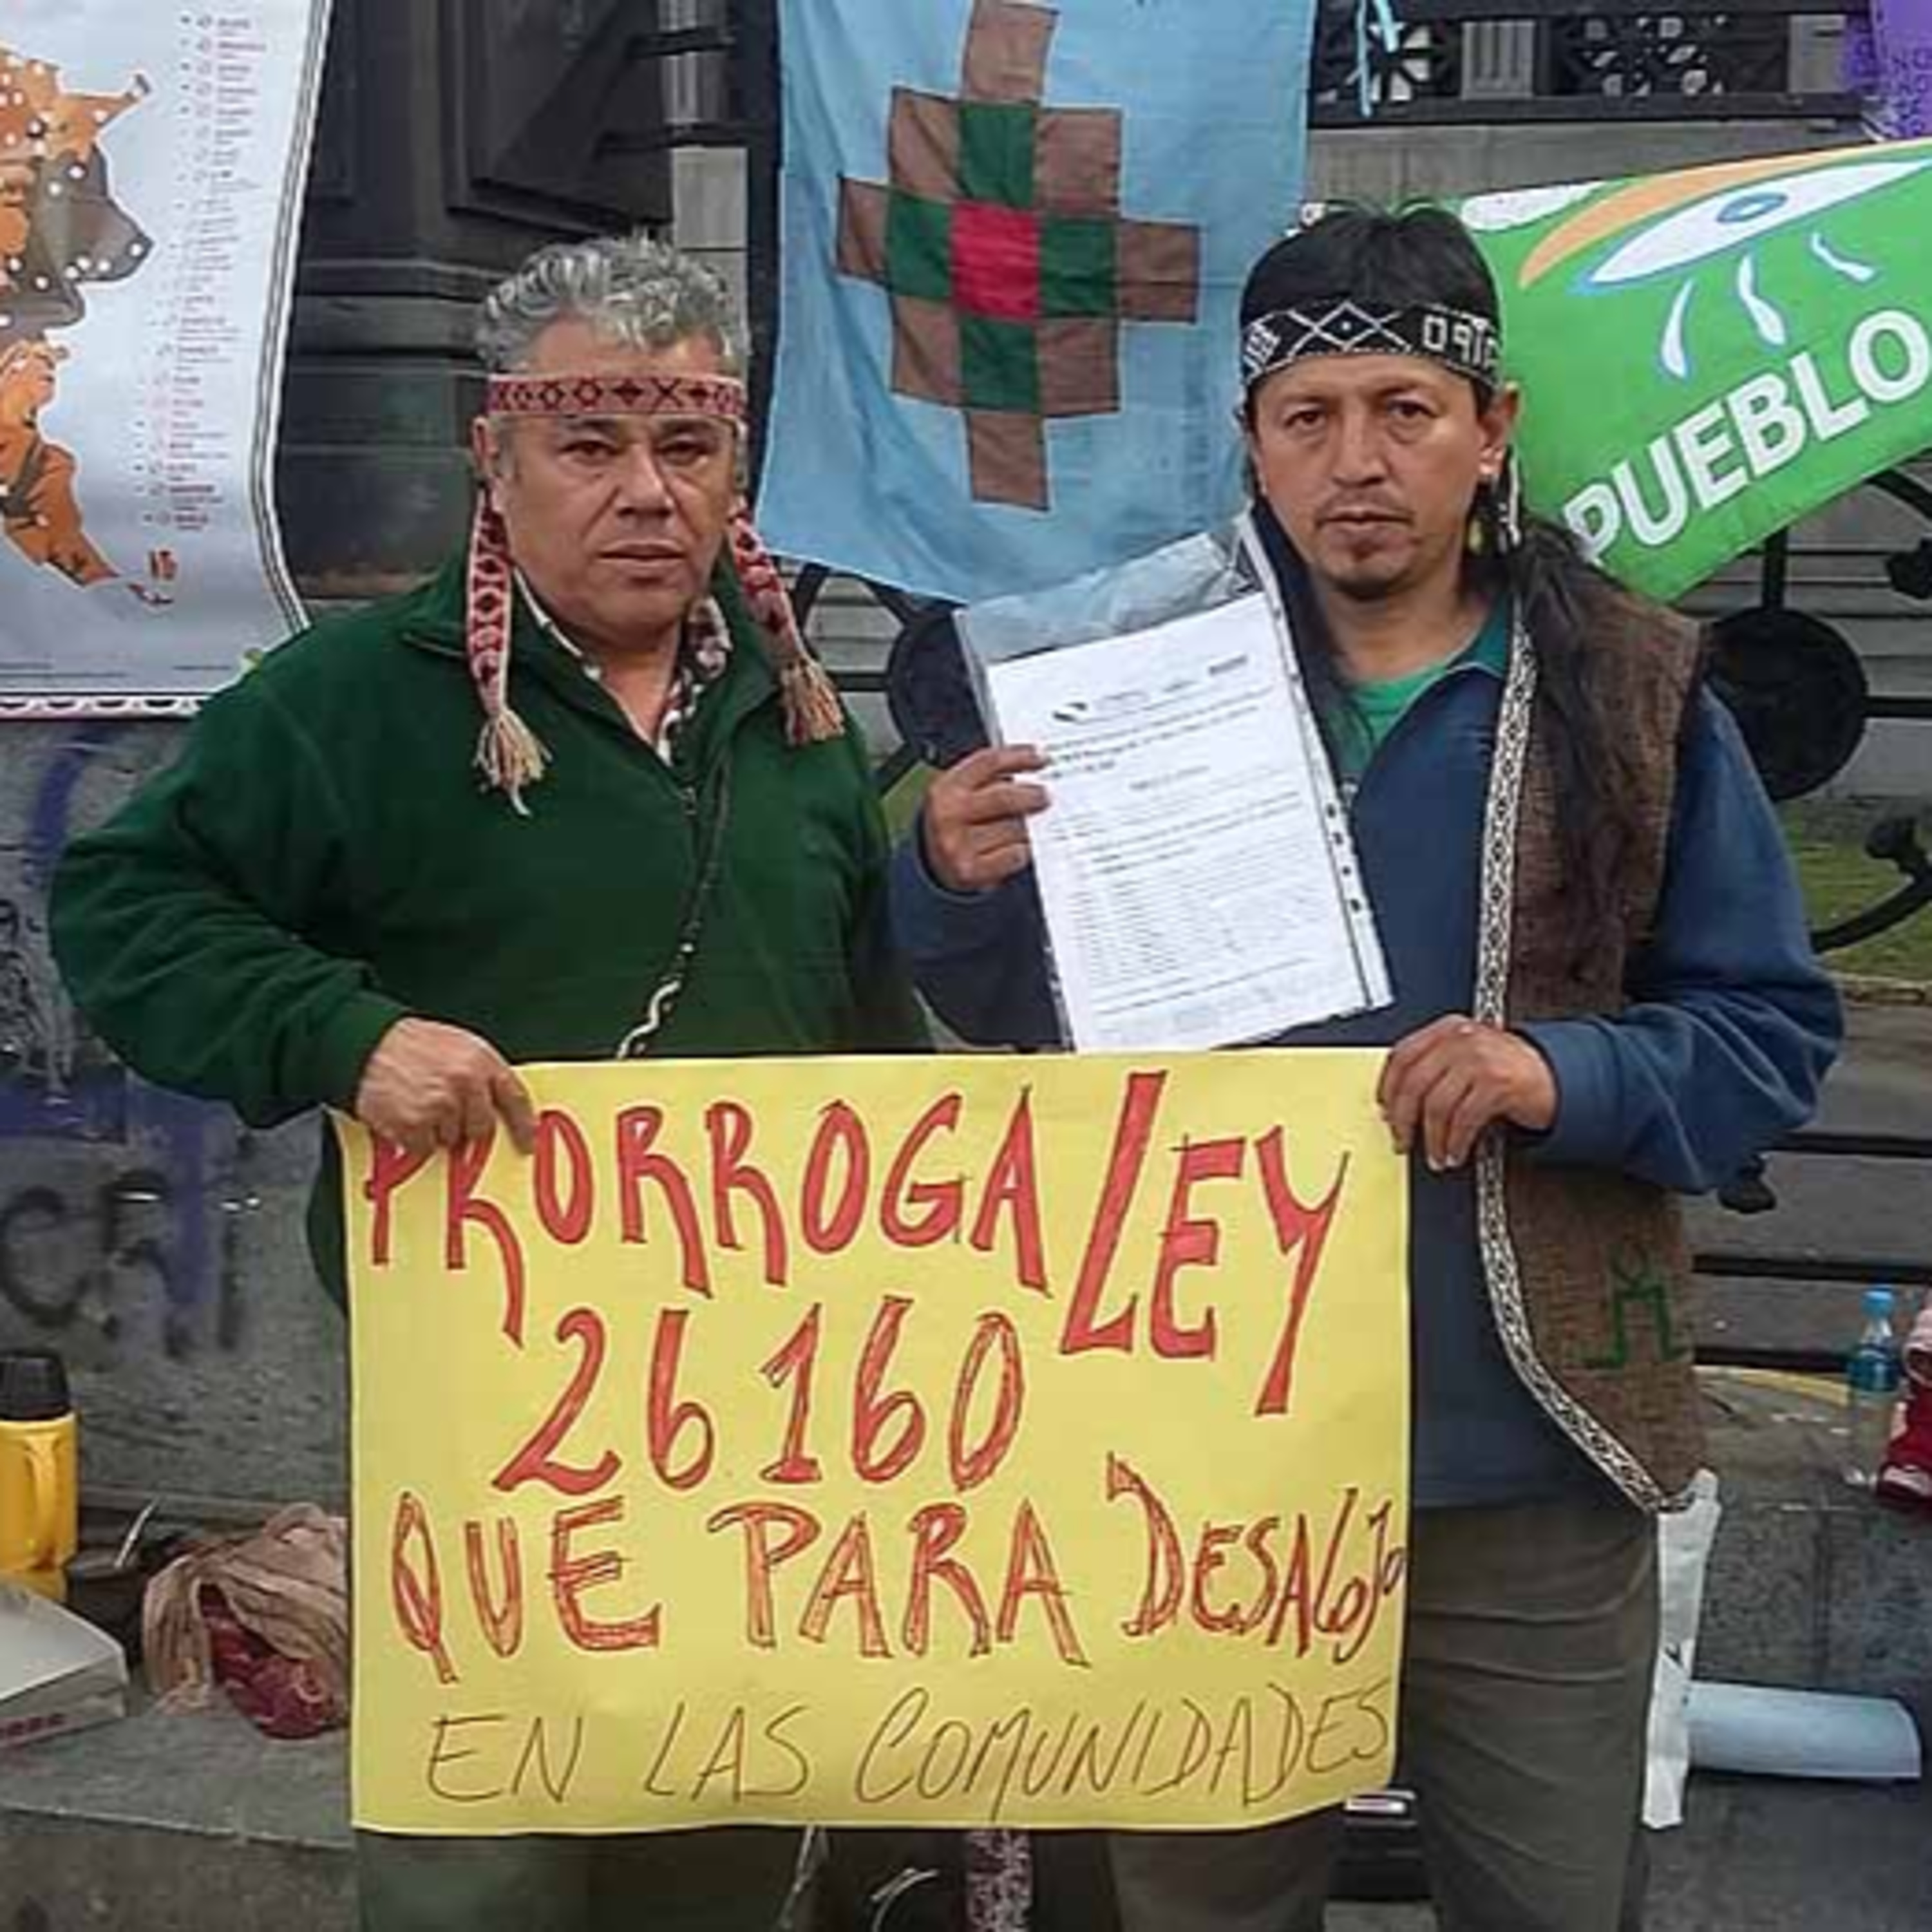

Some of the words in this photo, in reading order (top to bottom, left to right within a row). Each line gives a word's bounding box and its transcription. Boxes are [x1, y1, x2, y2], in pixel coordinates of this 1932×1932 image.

[1562, 309, 1931, 568] PUEBLO
[363, 1086, 1052, 1348] PRORROGA
[1058, 1070, 1349, 1416] LEY
[491, 1295, 1024, 1496] 26160
[392, 1492, 661, 1684] QUE
[708, 1499, 1090, 1668] PARA
[428, 1714, 582, 1803] EN
[644, 1703, 809, 1803] LAS
[854, 1676, 1391, 1821] COMUNIDADES
